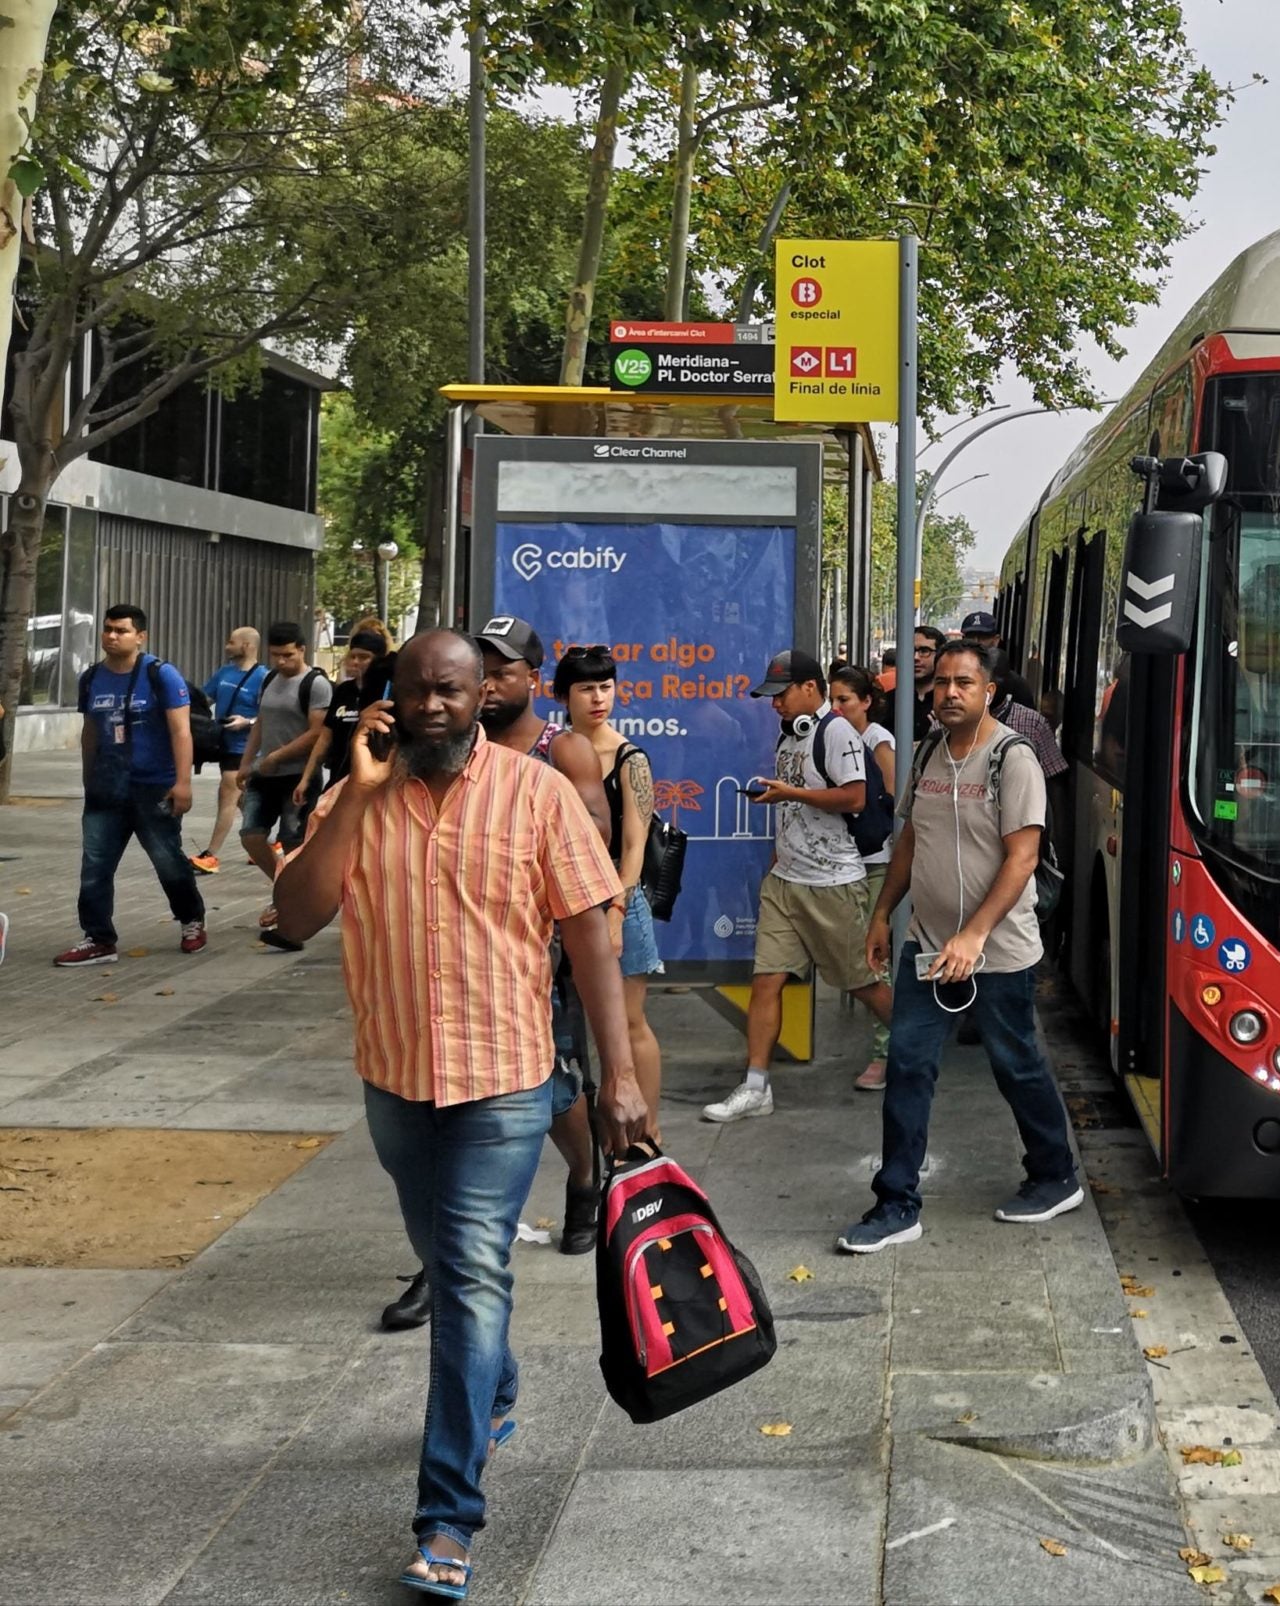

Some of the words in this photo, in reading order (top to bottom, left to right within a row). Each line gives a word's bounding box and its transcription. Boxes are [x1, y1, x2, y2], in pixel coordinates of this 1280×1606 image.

[791, 255, 826, 269] Clot
[798, 282, 817, 303] B
[790, 310, 841, 320] especial
[690, 329, 706, 337] Clot
[737, 332, 758, 341] 1494
[616, 358, 650, 374] V25
[800, 357, 812, 367] M
[829, 352, 852, 372] L1
[657, 369, 677, 382] Pl.
[680, 369, 731, 382] Doctor
[789, 382, 825, 395] Final
[828, 383, 847, 395] de
[851, 383, 881, 395] línia
[610, 446, 641, 457] Clear
[642, 447, 687, 458] Channel
[547, 547, 627, 572] cabify
[650, 637, 715, 668] algo
[662, 674, 750, 699] Reial?
